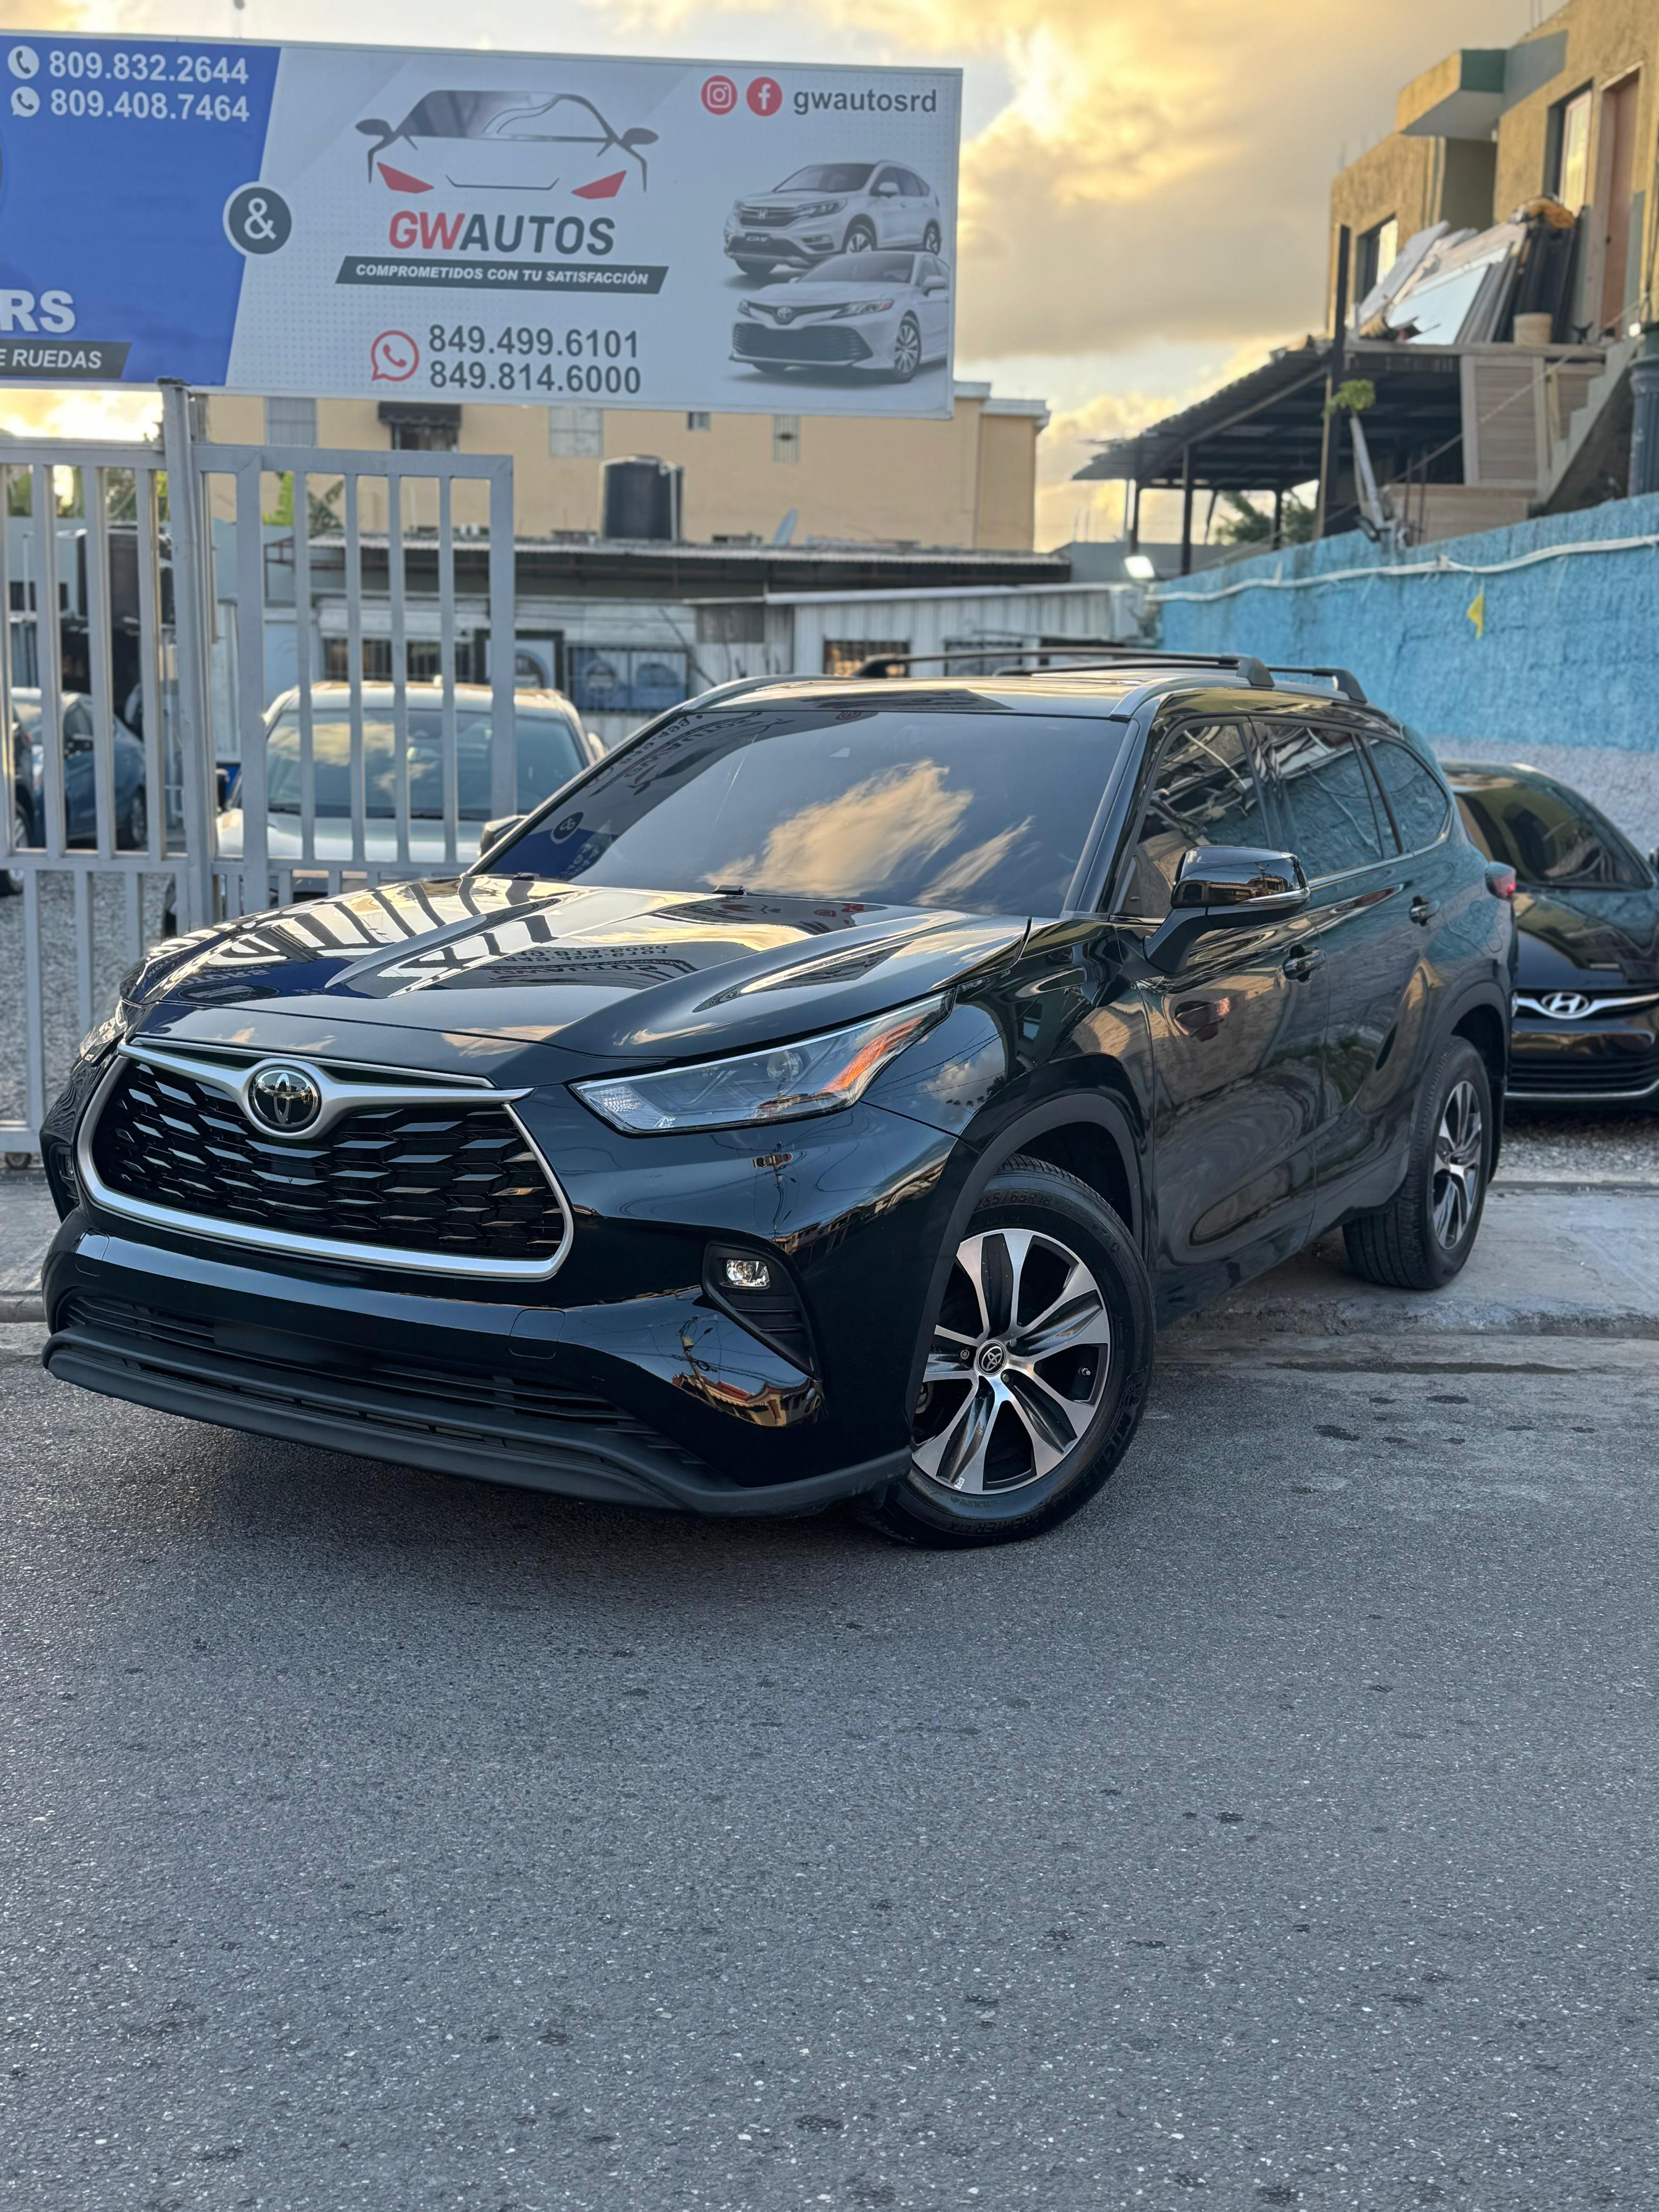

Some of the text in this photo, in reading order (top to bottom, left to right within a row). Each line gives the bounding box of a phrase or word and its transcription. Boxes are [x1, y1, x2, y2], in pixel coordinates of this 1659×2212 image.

[49, 51, 249, 84] 809.832.2644
[51, 89, 250, 122] 809.408.7464
[793, 89, 936, 114] gwautosrd
[244, 197, 276, 240] &
[388, 210, 615, 256] GWAUTOS
[356, 264, 648, 285] COMPROMETIDOS CON TU SATISFACCIÓN
[0, 289, 76, 333] RS
[429, 324, 638, 358] 849.499.6101
[12, 349, 102, 369] RUEDAS
[430, 360, 641, 394] 849.814.6000
